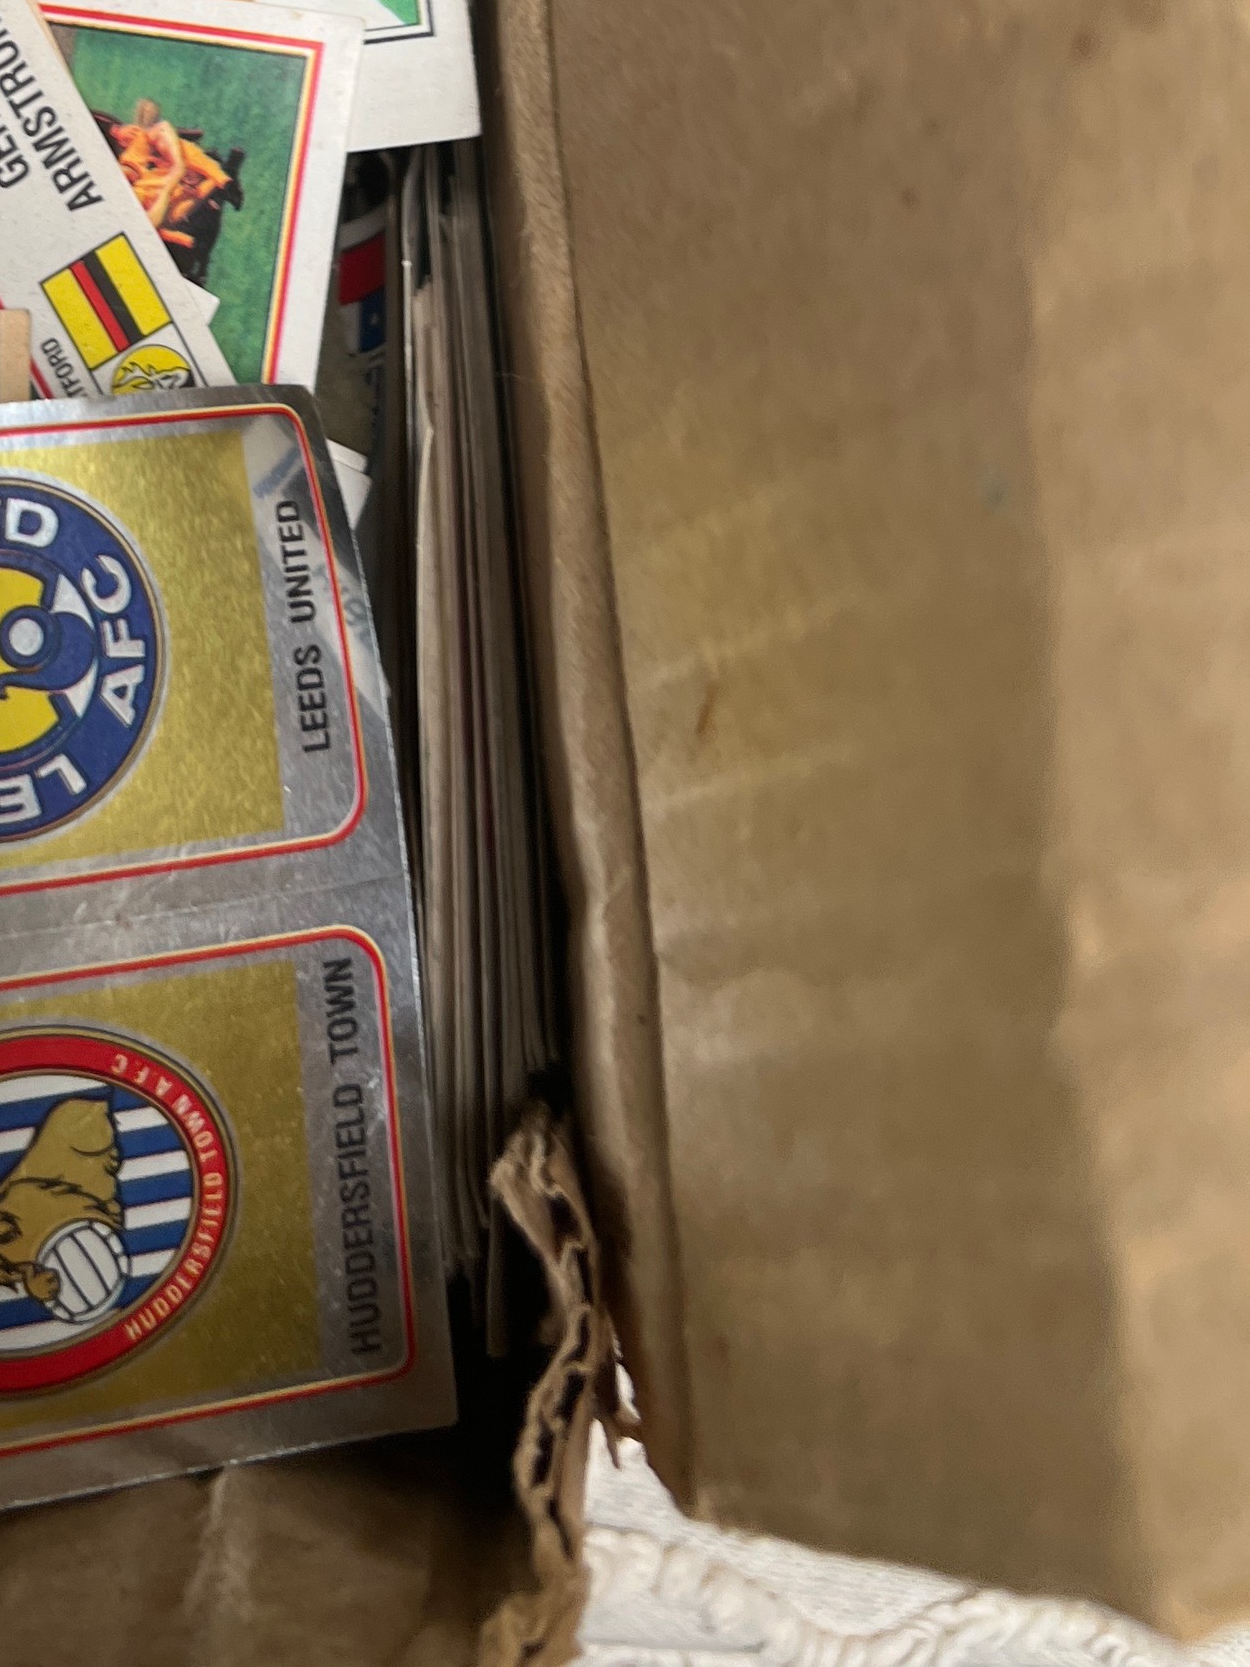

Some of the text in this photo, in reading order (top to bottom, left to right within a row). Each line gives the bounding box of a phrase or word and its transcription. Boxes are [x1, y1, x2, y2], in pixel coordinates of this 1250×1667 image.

[39, 335, 87, 399] TFORD
[81, 554, 146, 727] AFC
[276, 500, 331, 753] LEEDS UNITED
[323, 957, 383, 1356] HUDDERSFIELD TOWN
